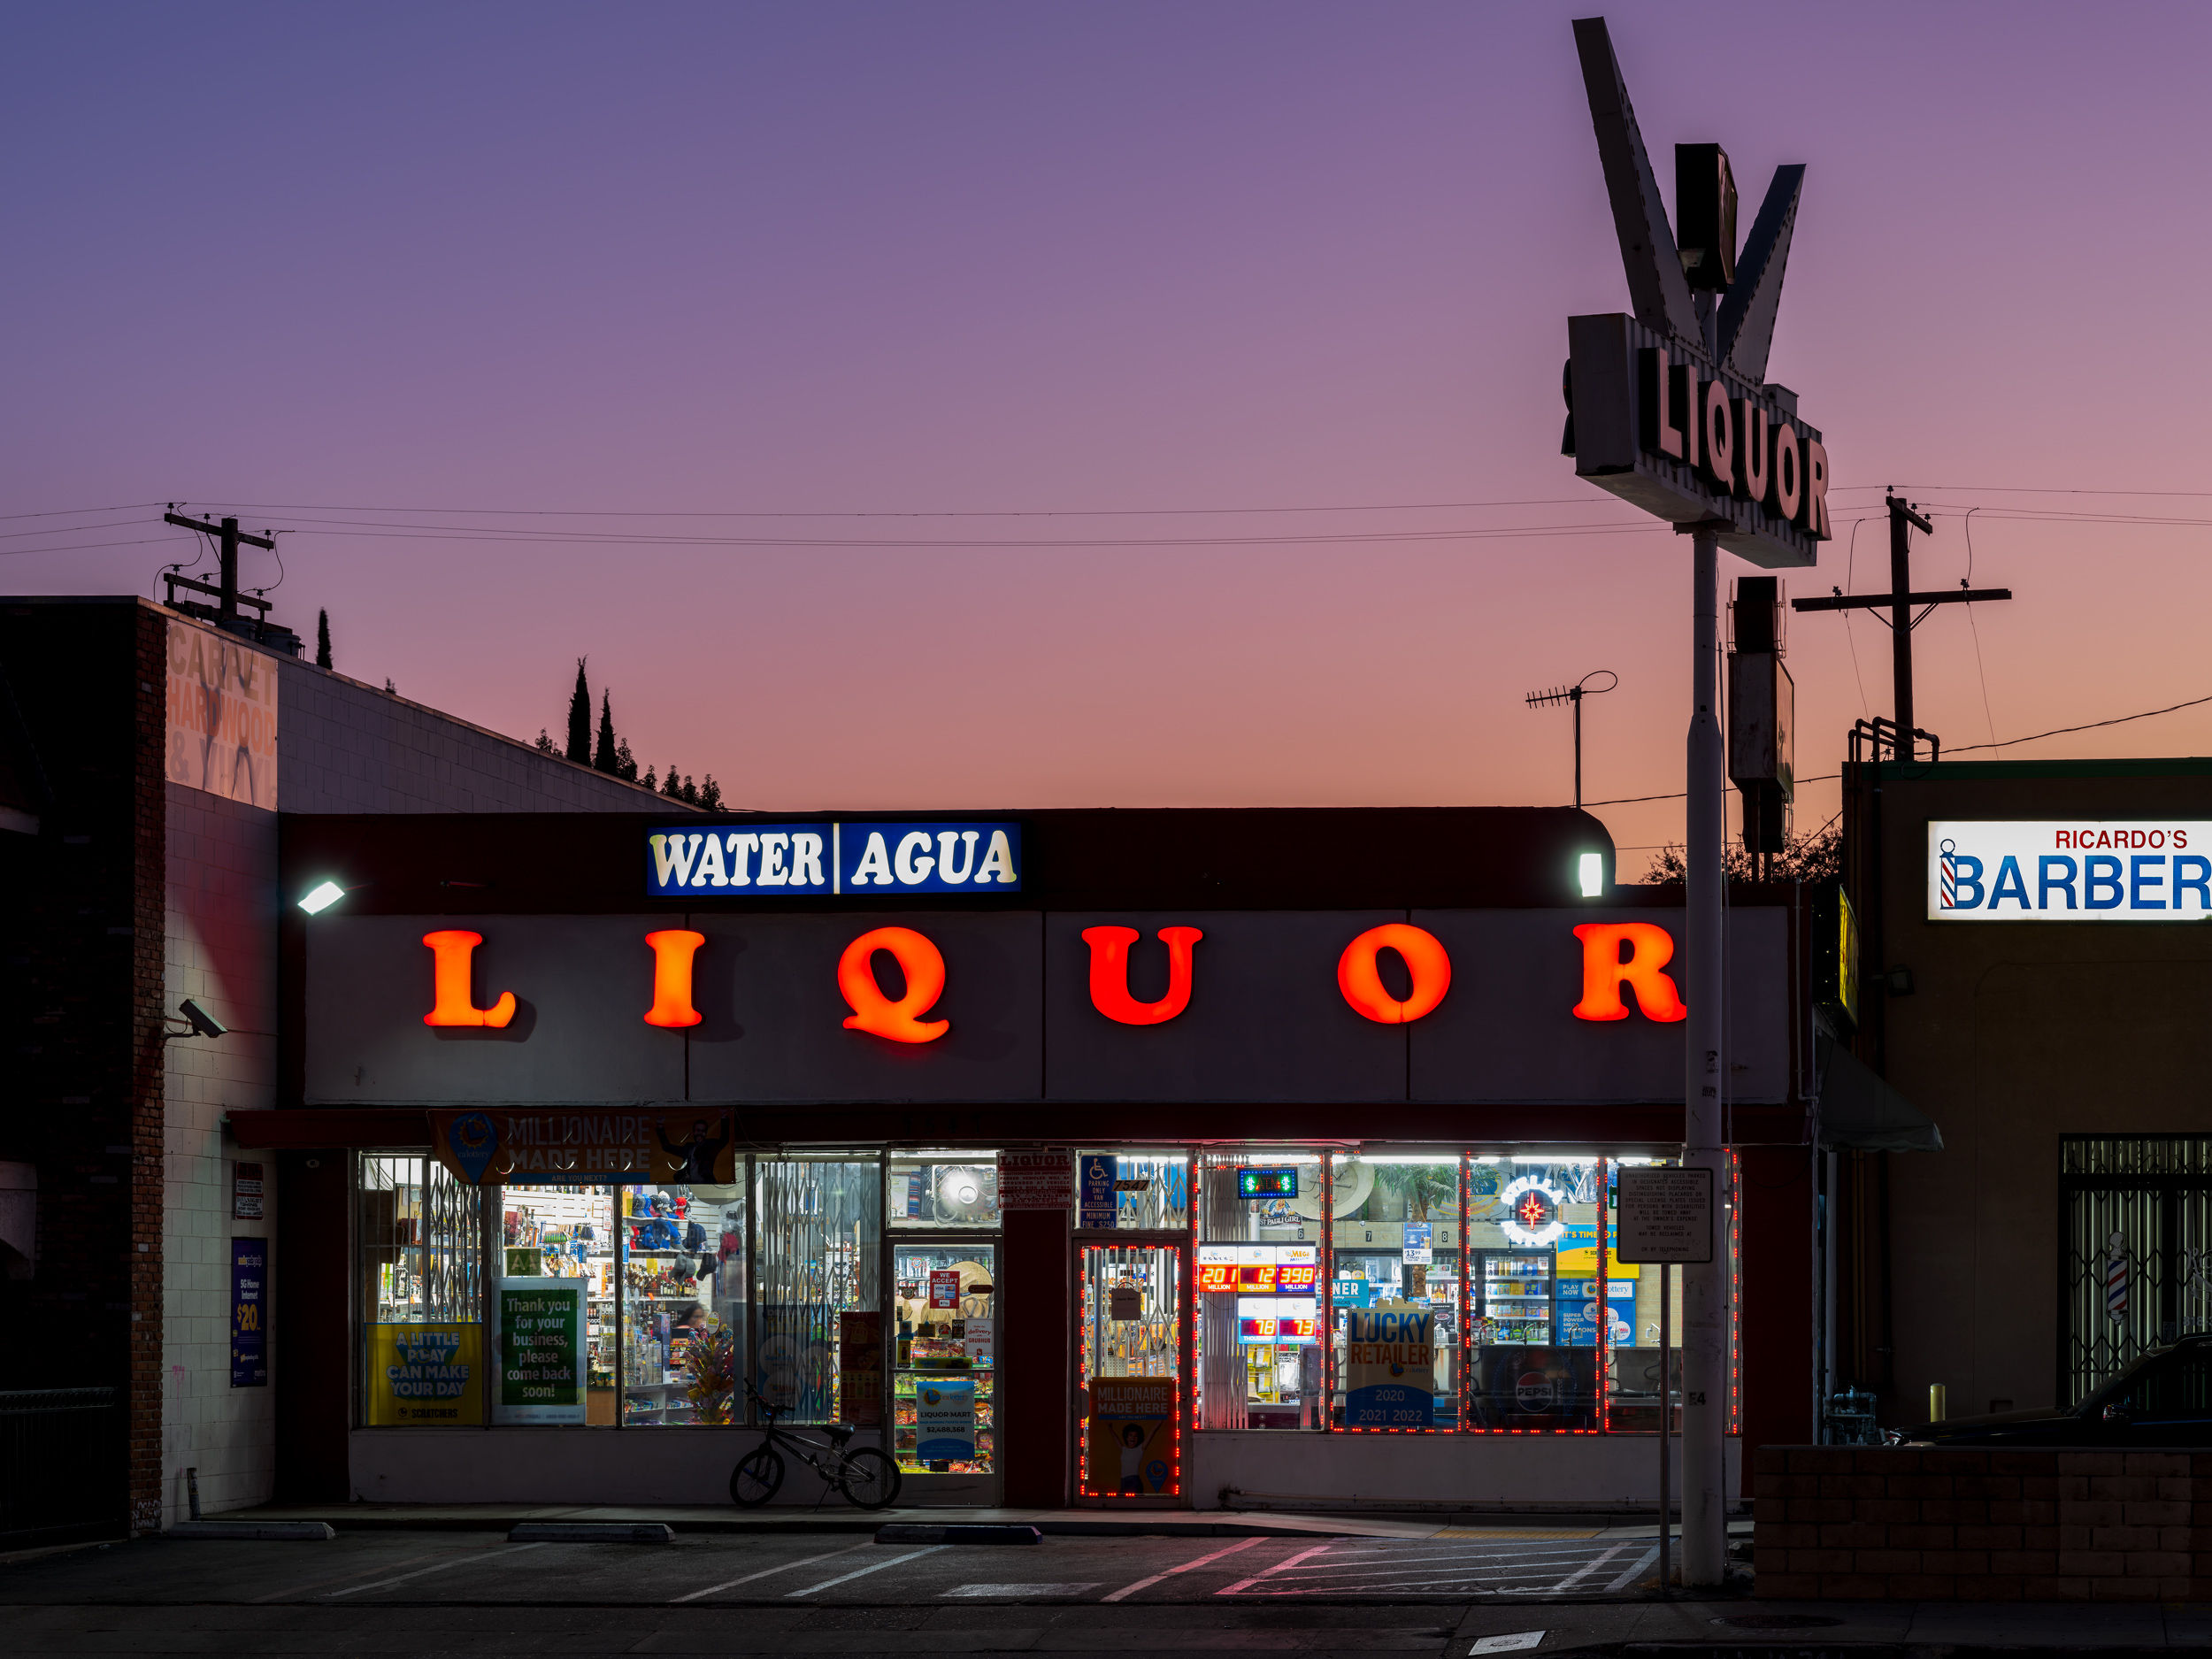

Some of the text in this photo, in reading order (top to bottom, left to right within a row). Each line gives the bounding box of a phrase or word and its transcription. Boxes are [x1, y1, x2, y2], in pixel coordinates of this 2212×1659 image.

[1655, 348, 1832, 541] LIQUOR
[169, 625, 277, 706] CARPET
[166, 675, 276, 757] HARDWOOD
[2055, 829, 2187, 849] RICARDO'S
[649, 830, 1017, 887] WATER AGUA
[1952, 855, 2212, 910] BARBER
[423, 923, 1687, 1044] LIQUOR
[508, 1115, 650, 1146] MILLIONAIRE
[509, 1148, 650, 1170] MADE HERE
[1000, 1155, 1070, 1166] LIQUOR
[1112, 1180, 1149, 1191] 7547
[1366, 1232, 1371, 1241] 7
[1441, 1232, 1448, 1241] 8
[1202, 1267, 1237, 1283] 201
[1257, 1267, 1275, 1283] 12
[1279, 1267, 1314, 1283] 398
[507, 1297, 571, 1317] Thank you
[236, 1302, 258, 1332] $20
[515, 1314, 565, 1333] for your
[1255, 1319, 1275, 1335] 78
[1294, 1319, 1314, 1335] 73
[1351, 1312, 1430, 1343] LUCKY
[396, 1332, 460, 1346] A LITTLE
[512, 1332, 568, 1348] business,
[518, 1348, 558, 1367] please
[1351, 1344, 1430, 1365] RETAILER
[387, 1365, 470, 1379] CAN MAKE
[506, 1366, 571, 1381] come back
[389, 1381, 466, 1396] YOUR DAY
[522, 1383, 556, 1398] soon!
[1097, 1386, 1168, 1402] MILLIONAIRE
[1375, 1389, 1405, 1402] 2020
[1517, 1387, 1552, 1396] PEPSI
[411, 1408, 458, 1418] SCRATCHERS
[1097, 1402, 1168, 1414] MADE HERE
[1359, 1409, 1423, 1422] 2021 2022
